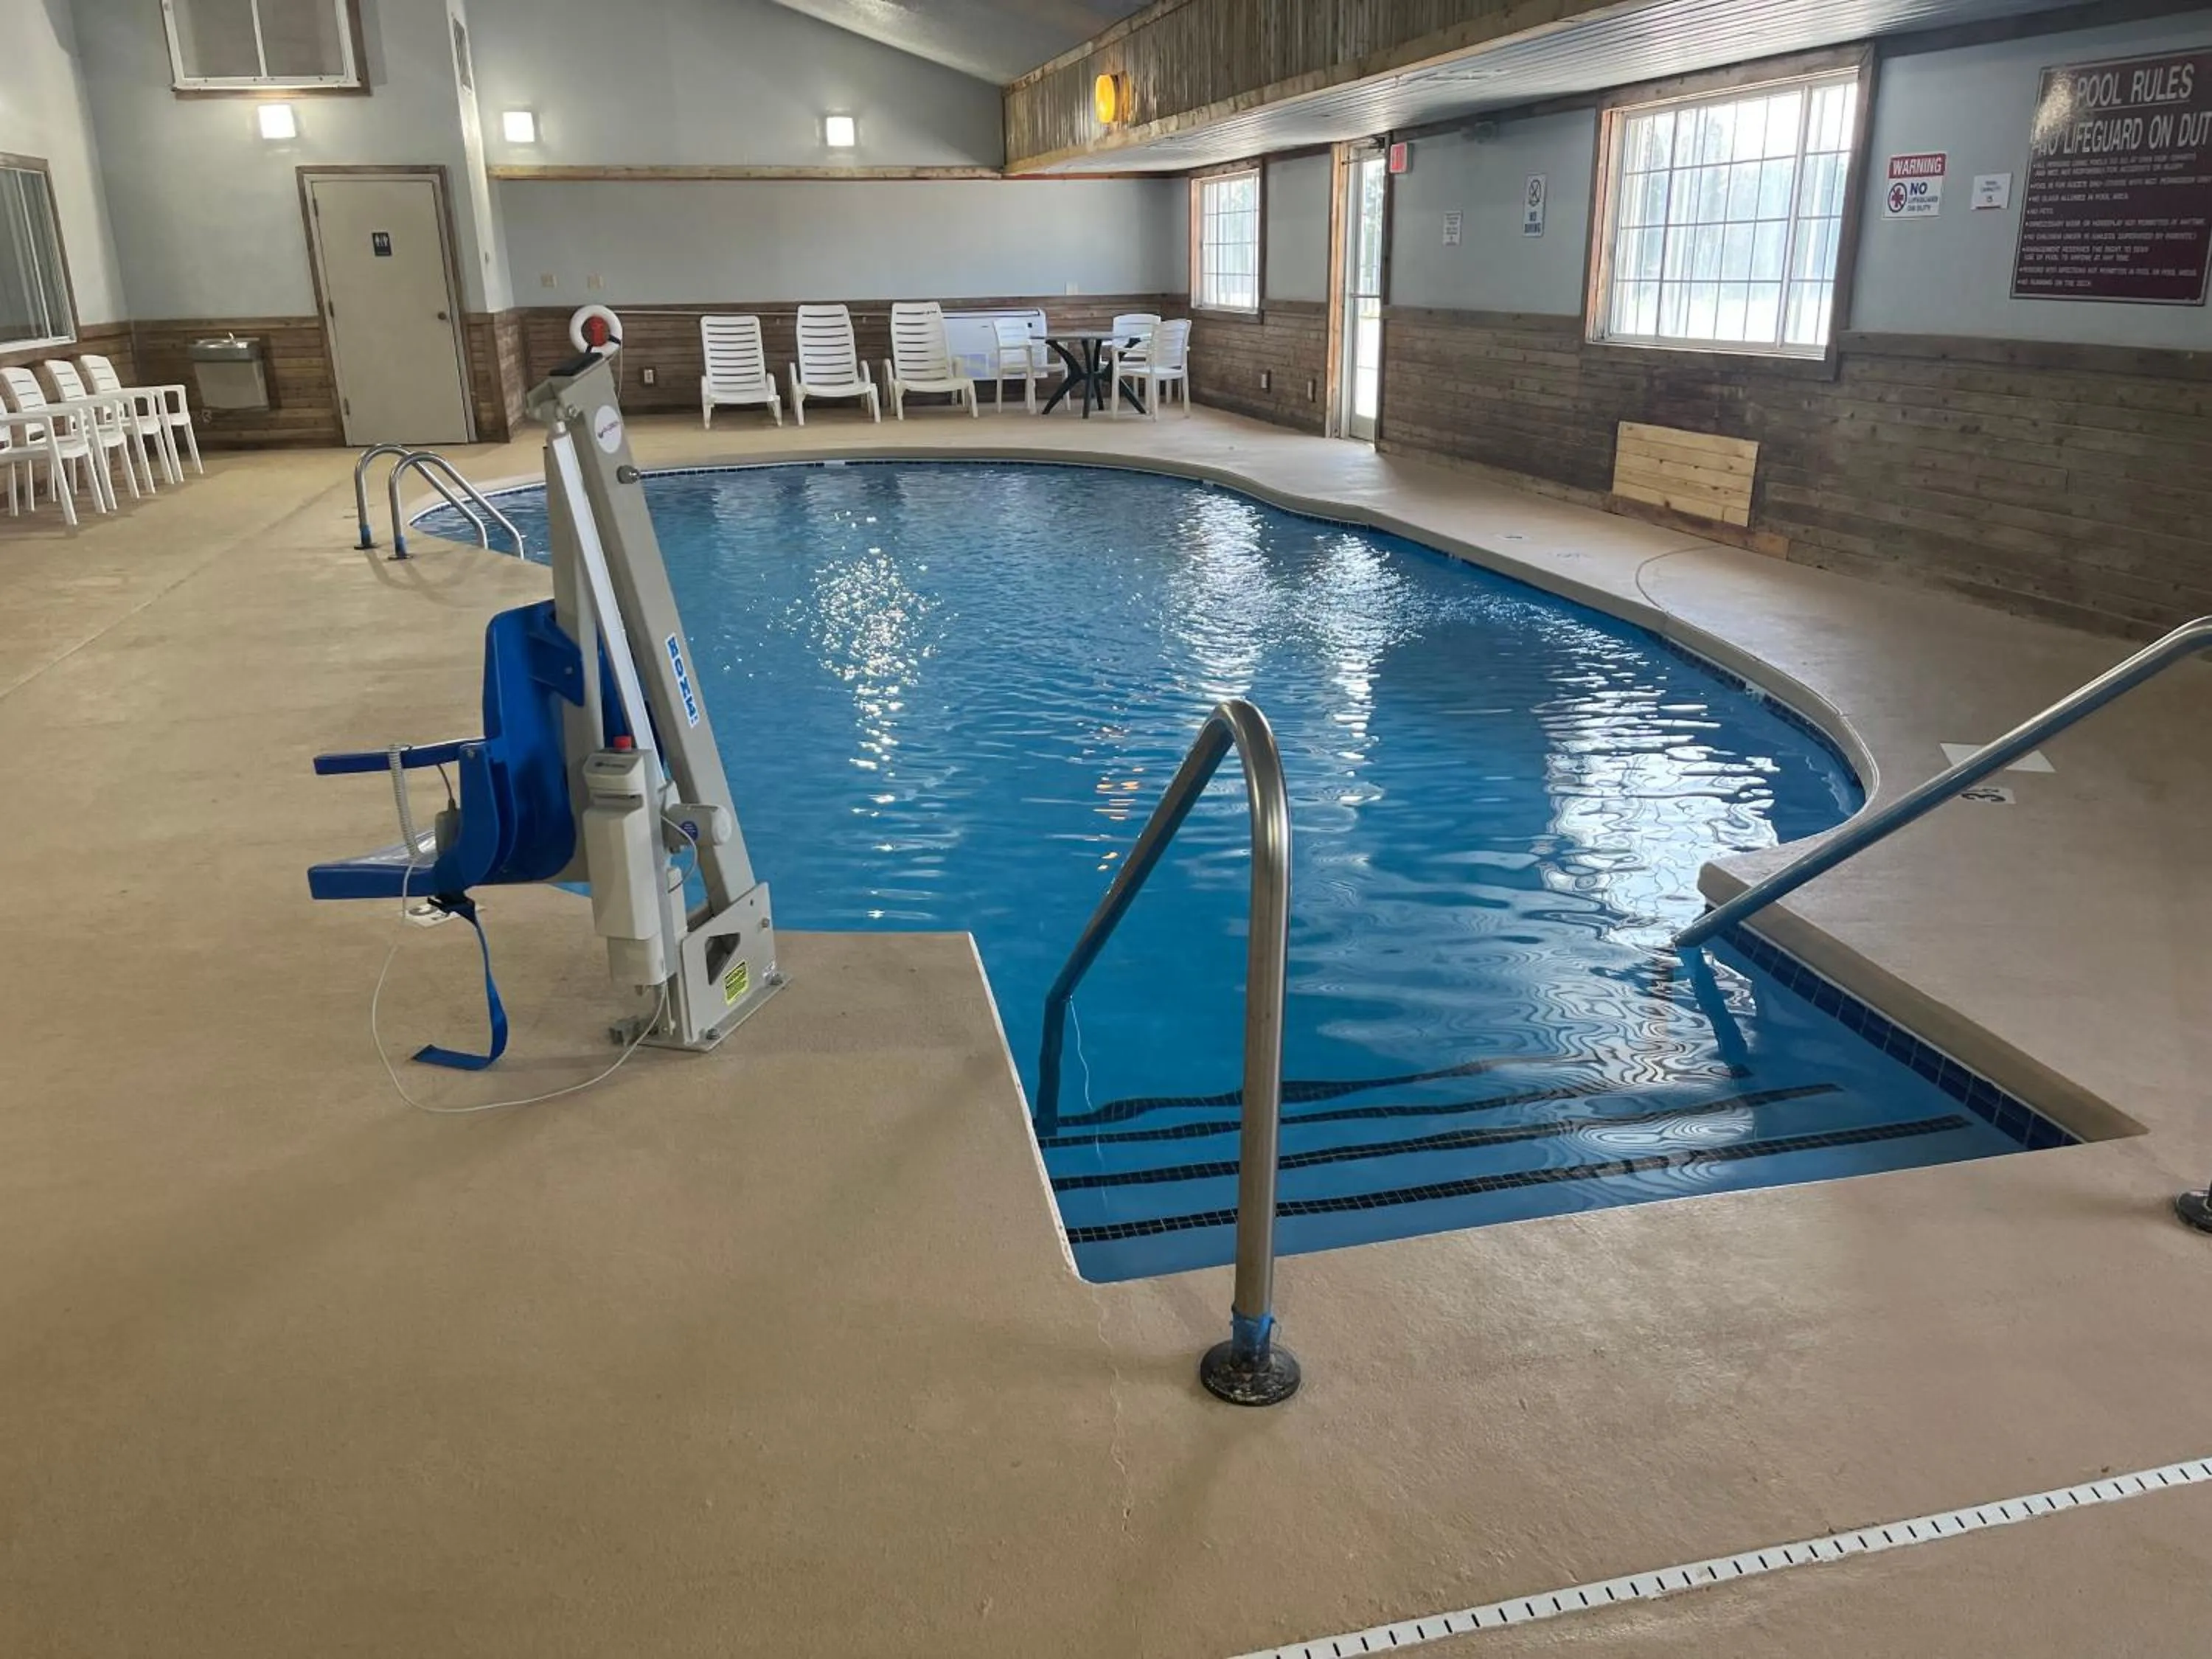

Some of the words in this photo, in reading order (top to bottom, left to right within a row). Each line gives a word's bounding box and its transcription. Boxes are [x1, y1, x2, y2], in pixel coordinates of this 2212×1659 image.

[2076, 72, 2122, 107] POOL
[2130, 63, 2195, 102] RULES
[2063, 117, 2143, 154] LIFEGUARD
[2148, 114, 2174, 148] ON
[1893, 156, 1942, 175] WARNING
[1910, 182, 1928, 195] NO
